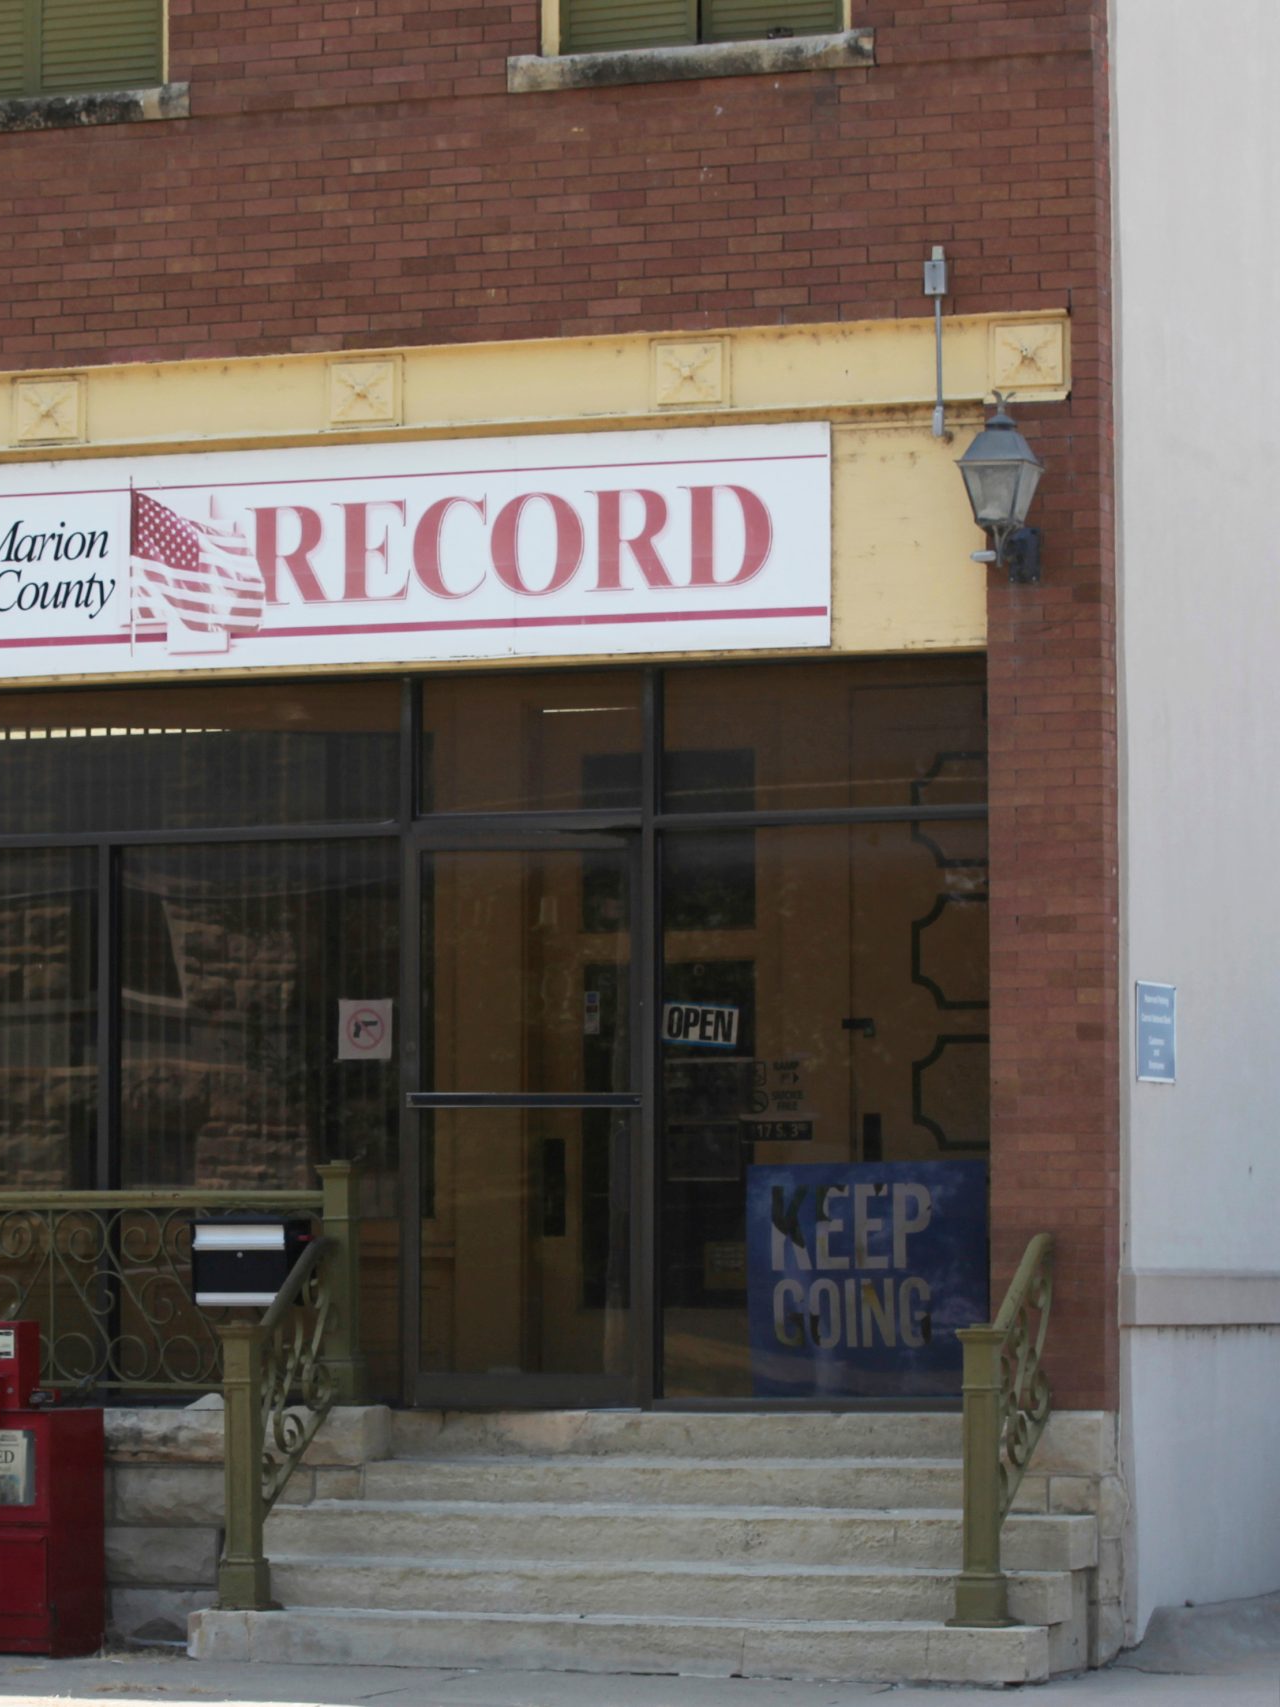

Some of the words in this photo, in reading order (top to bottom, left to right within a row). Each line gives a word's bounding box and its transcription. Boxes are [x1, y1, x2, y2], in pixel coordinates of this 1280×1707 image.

[245, 483, 774, 606] RECORD
[668, 1006, 734, 1042] OPEN
[771, 1183, 932, 1272] KEEP
[773, 1277, 932, 1349] GOING
